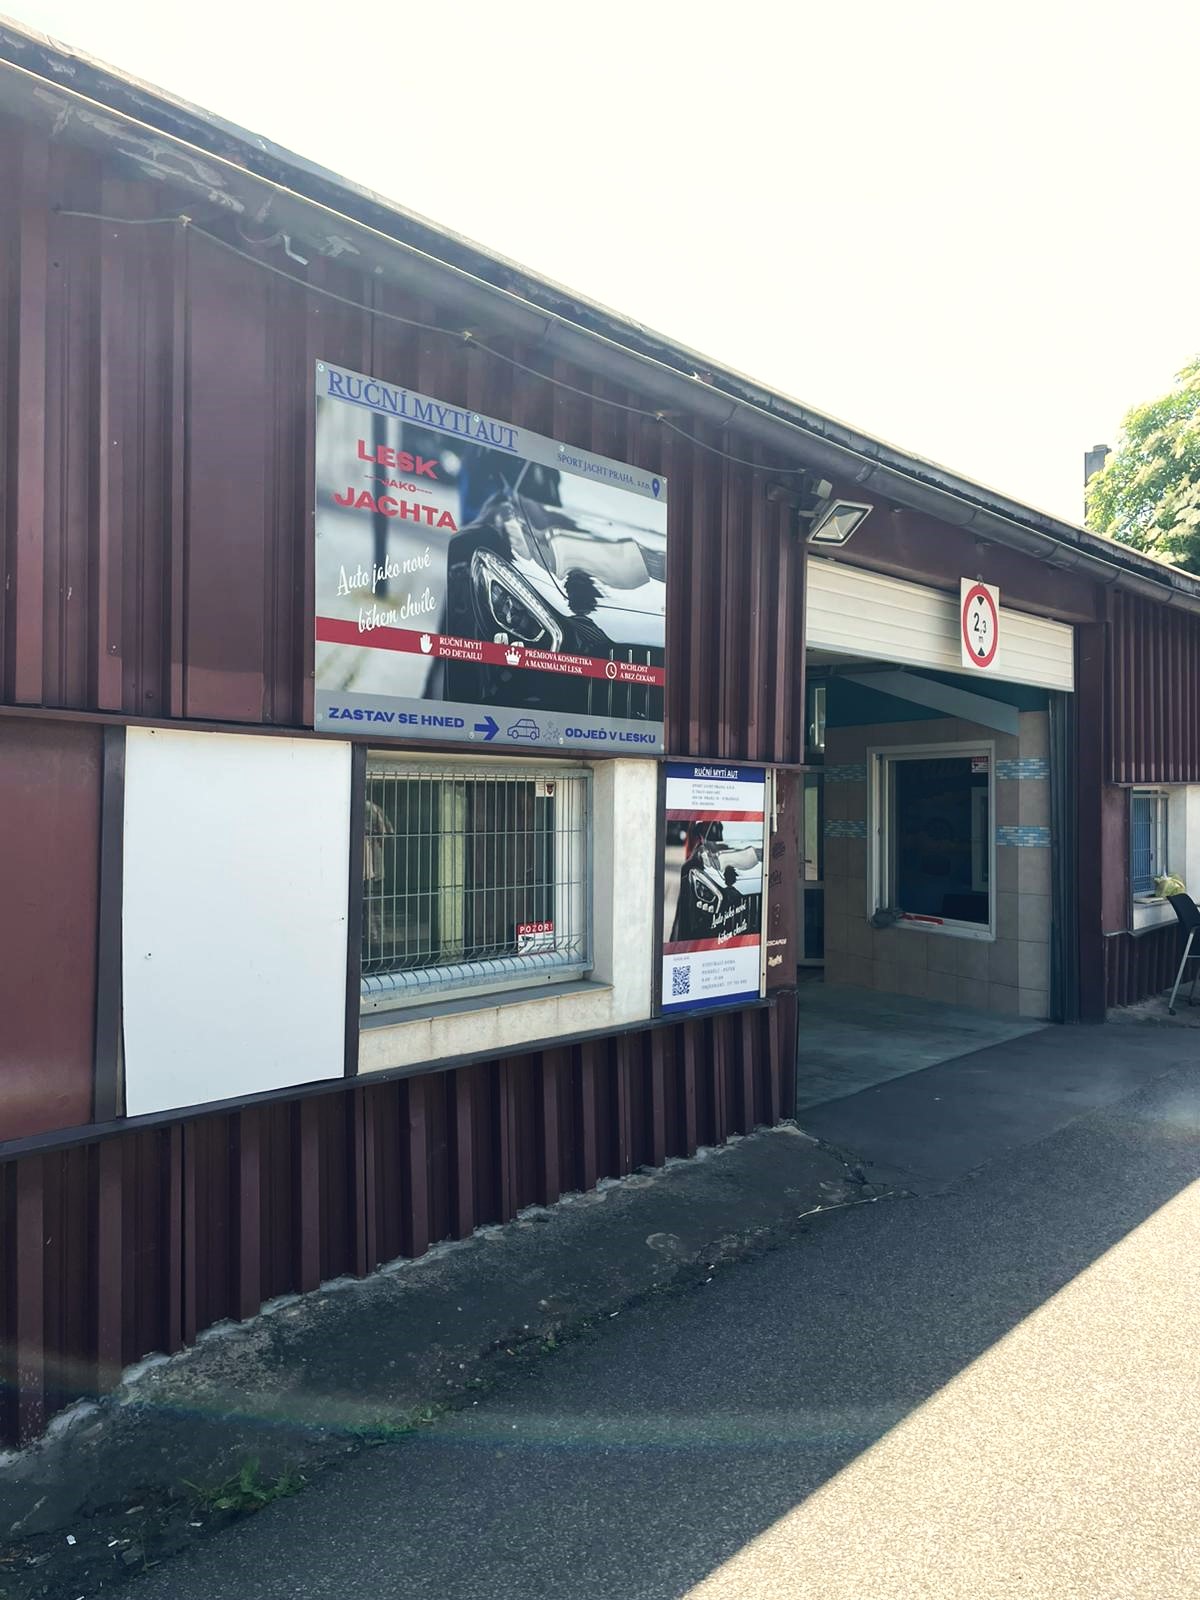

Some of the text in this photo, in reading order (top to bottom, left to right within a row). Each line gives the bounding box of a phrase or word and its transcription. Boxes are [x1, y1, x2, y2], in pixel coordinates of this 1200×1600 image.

[328, 370, 518, 449] RUČNÍ MYTÍ AUT
[357, 439, 440, 480] LESK
[557, 452, 583, 469] SPORT
[584, 461, 608, 477] JACHT
[381, 478, 417, 493] JAKO
[333, 487, 458, 531] JACHTA
[336, 547, 432, 596] Auto jako nové
[358, 587, 437, 633] během chvíle
[439, 637, 482, 650] RUČNÍ MYTÍ
[439, 647, 483, 661] DO DETAILU
[557, 655, 593, 666] KOSMETIKA
[567, 665, 583, 674] LESK
[620, 662, 648, 673] RYCHLOST
[328, 707, 465, 728] ZASTAV SE HNED
[565, 727, 656, 744] ODJEĎ V LESKU
[694, 766, 713, 776] RUČNÍ
[727, 770, 738, 779] AUT
[519, 923, 553, 934] POZOR!
